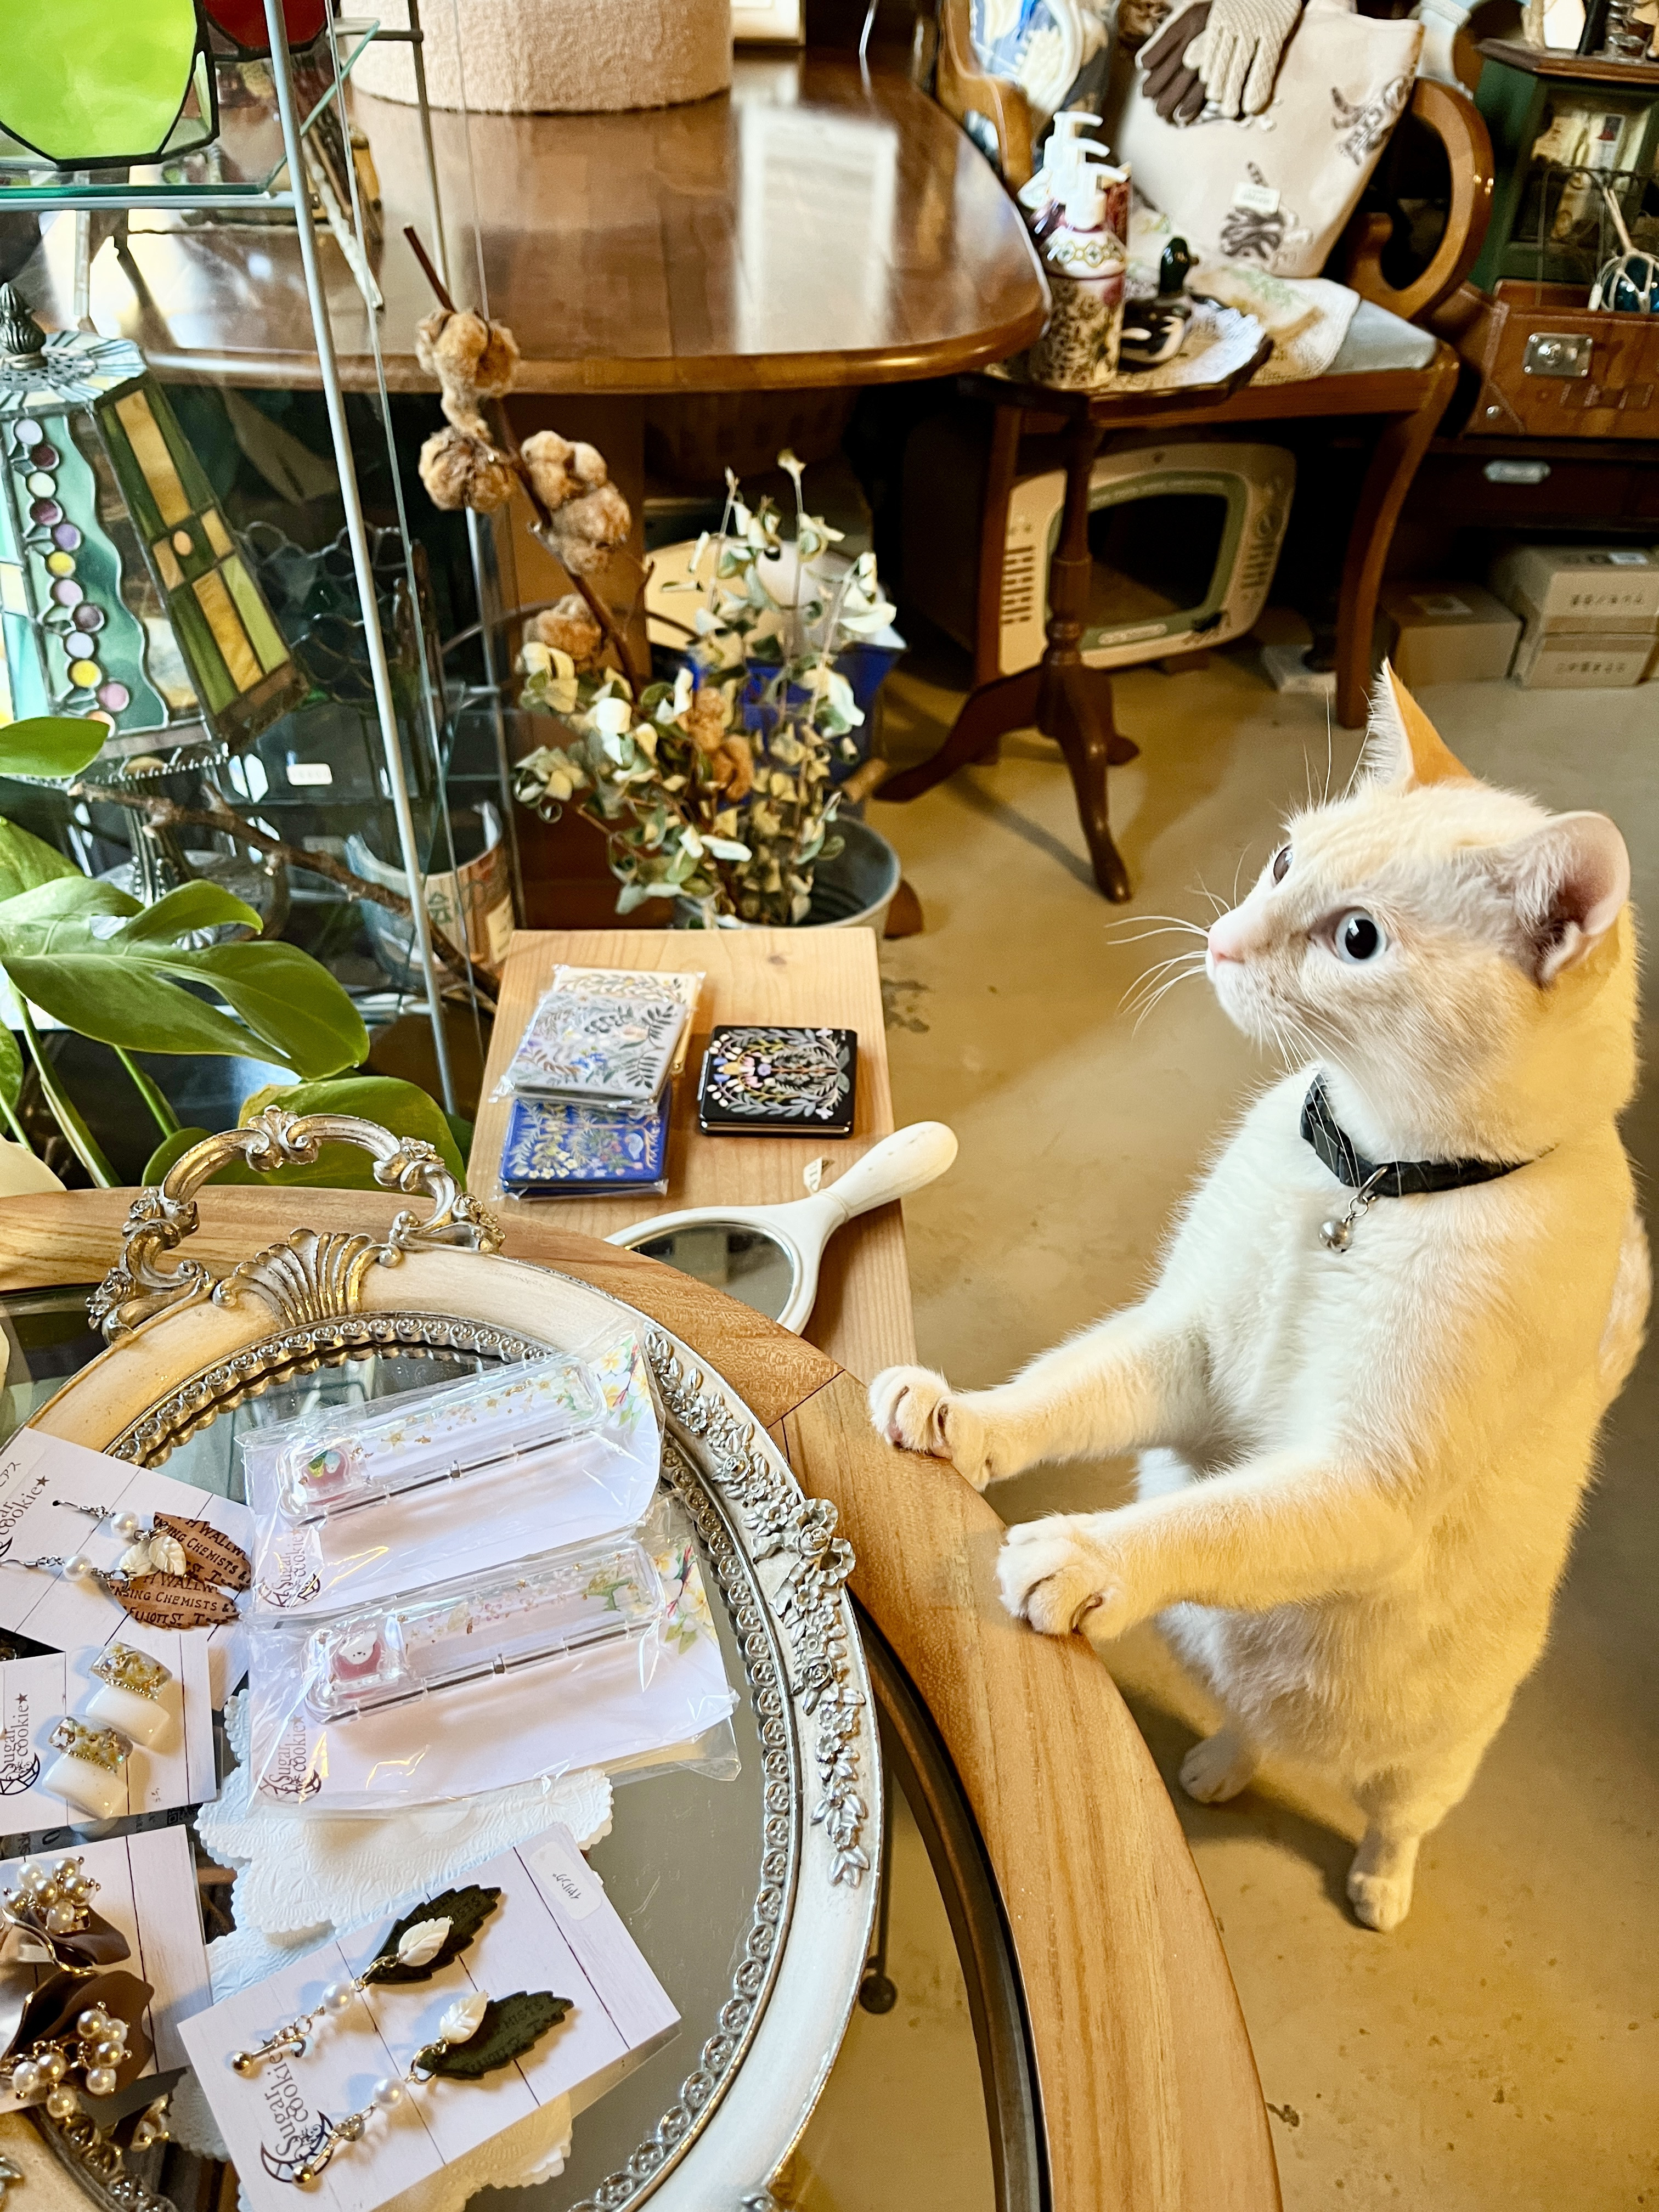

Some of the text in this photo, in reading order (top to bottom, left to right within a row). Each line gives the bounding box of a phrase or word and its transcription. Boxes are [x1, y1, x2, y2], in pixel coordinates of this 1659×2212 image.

[187, 1537, 239, 1575] CHEMISTS
[155, 1591, 218, 1611] CHEMISTS
[10, 1705, 29, 1757] cookie
[284, 1725, 307, 1773] cookie
[269, 1745, 295, 1782] Sugar
[267, 2051, 309, 2123] cookie
[264, 2092, 300, 2157] Sugar
